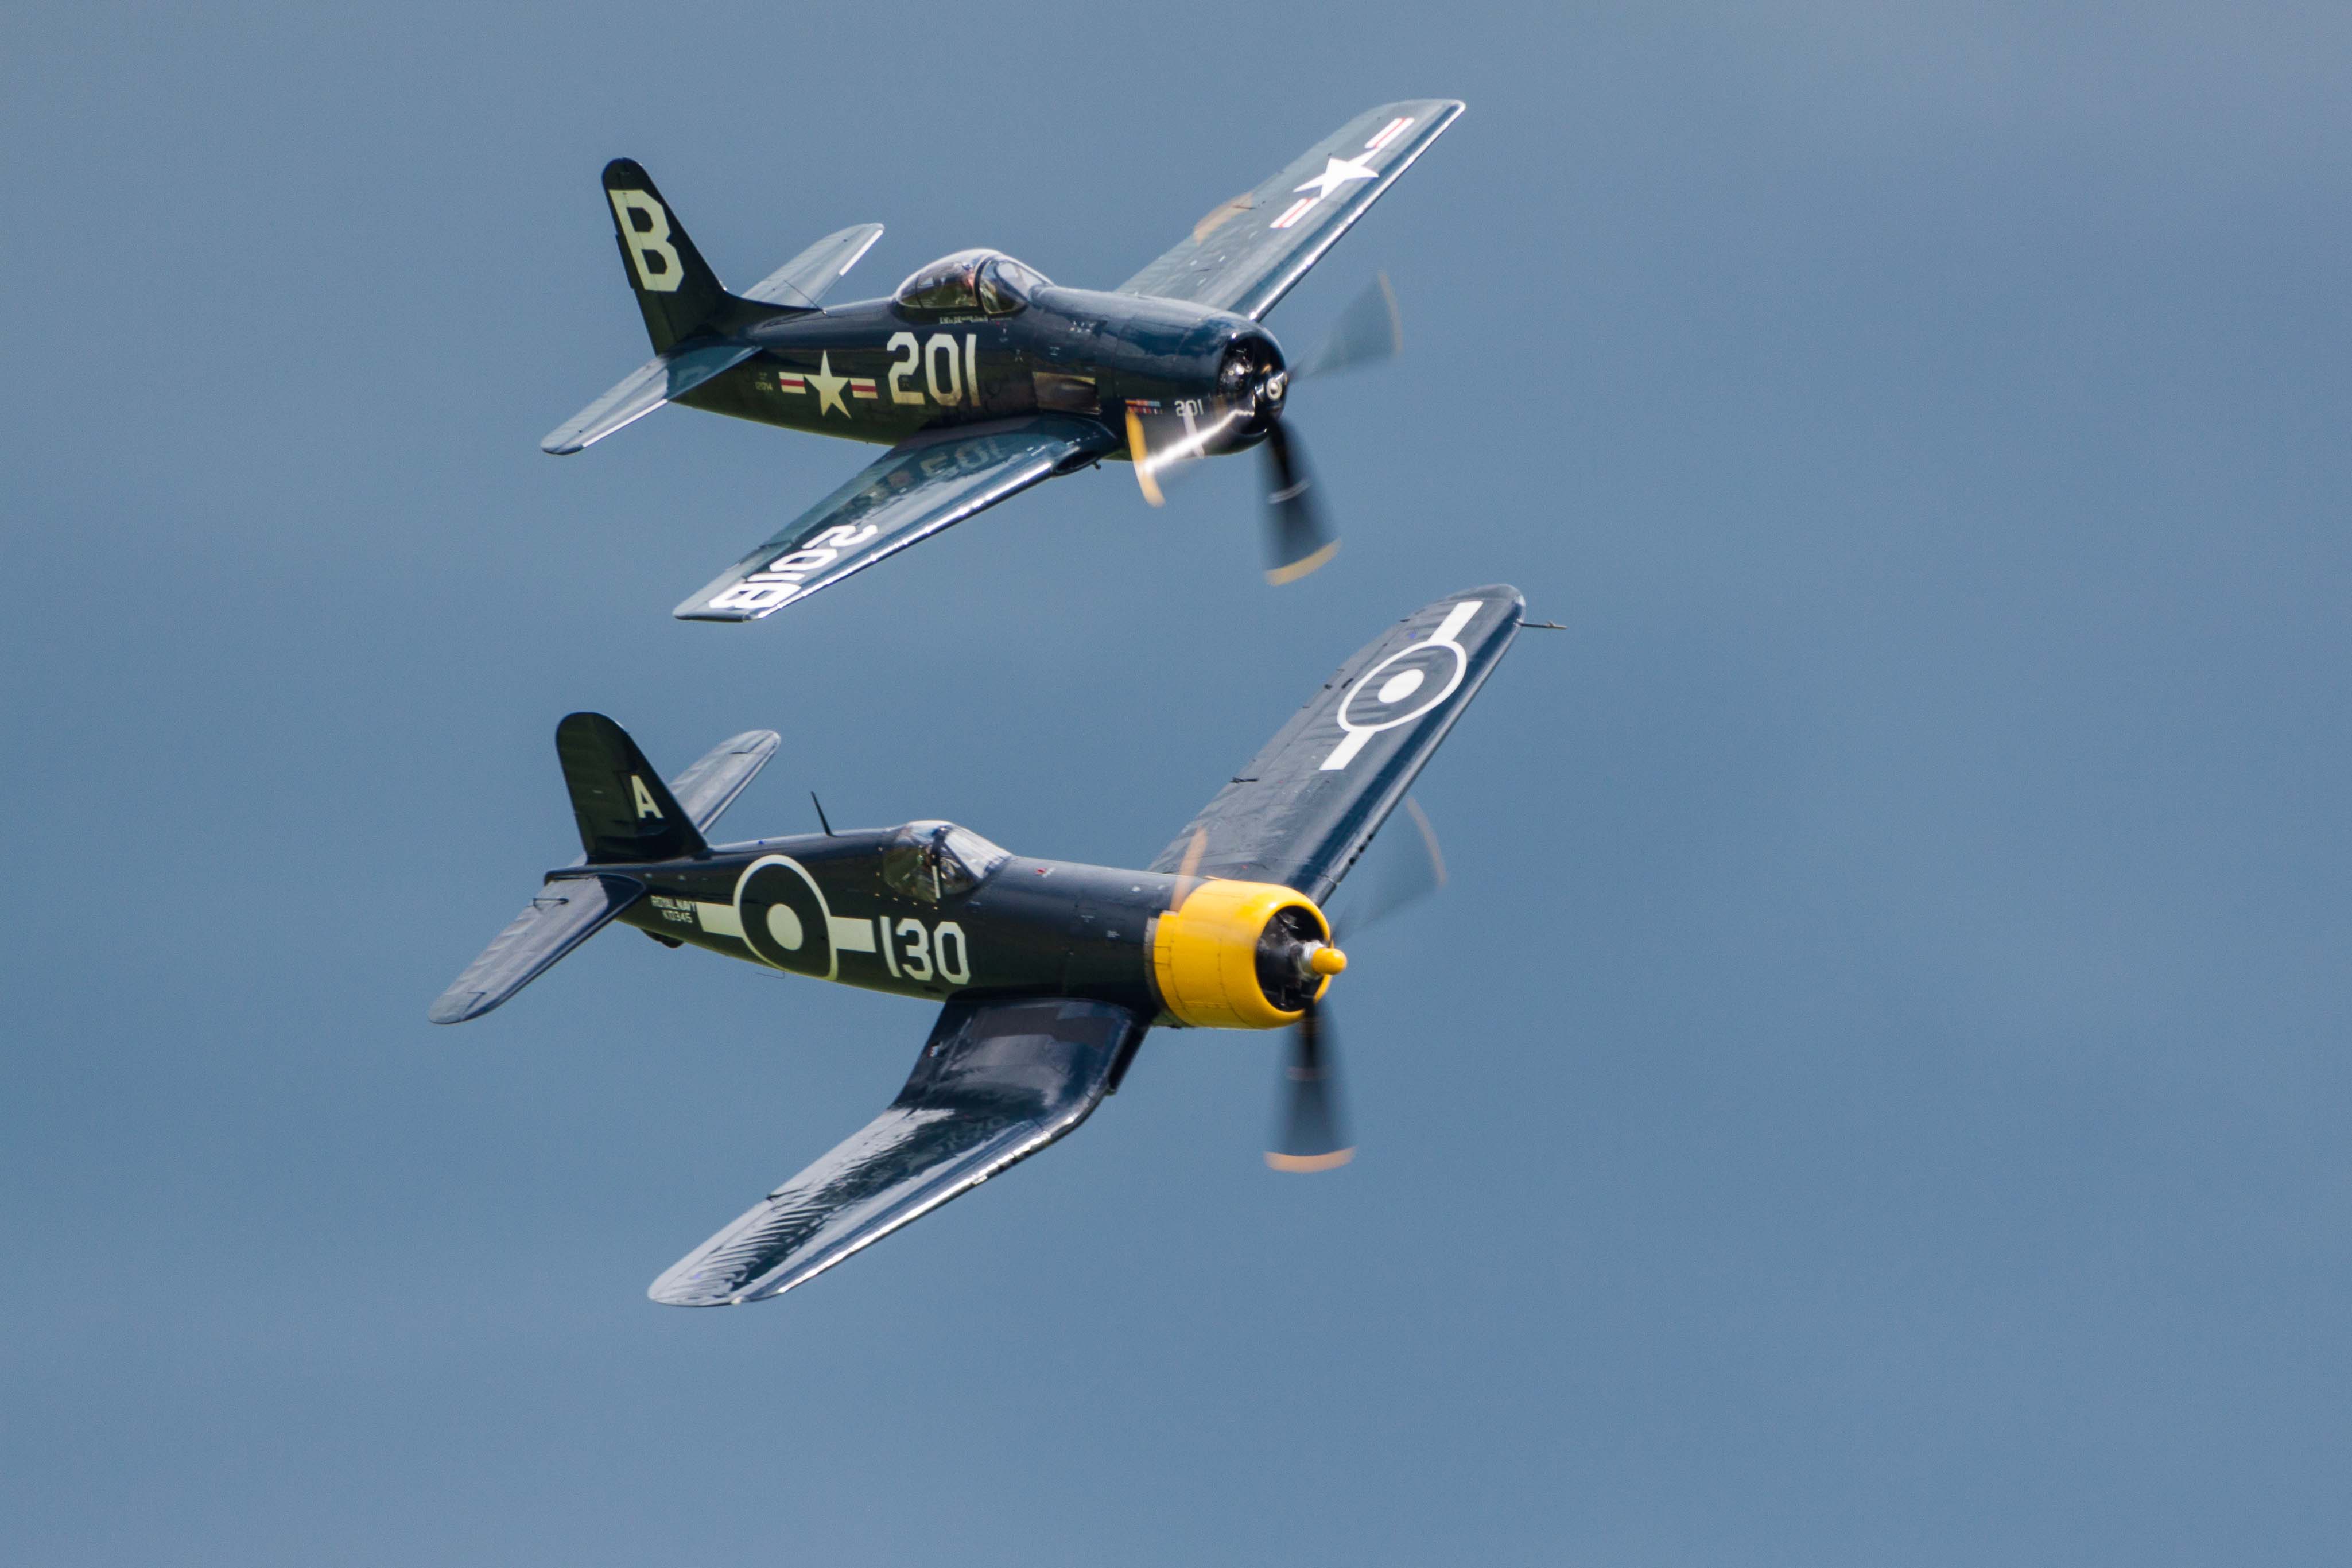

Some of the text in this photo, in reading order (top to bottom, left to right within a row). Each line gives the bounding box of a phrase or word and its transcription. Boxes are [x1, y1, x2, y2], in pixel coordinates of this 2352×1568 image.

[609, 189, 684, 292] B
[887, 331, 980, 407] 201
[1175, 399, 1204, 417] 201
[631, 775, 663, 818] A
[880, 916, 971, 985] 130
